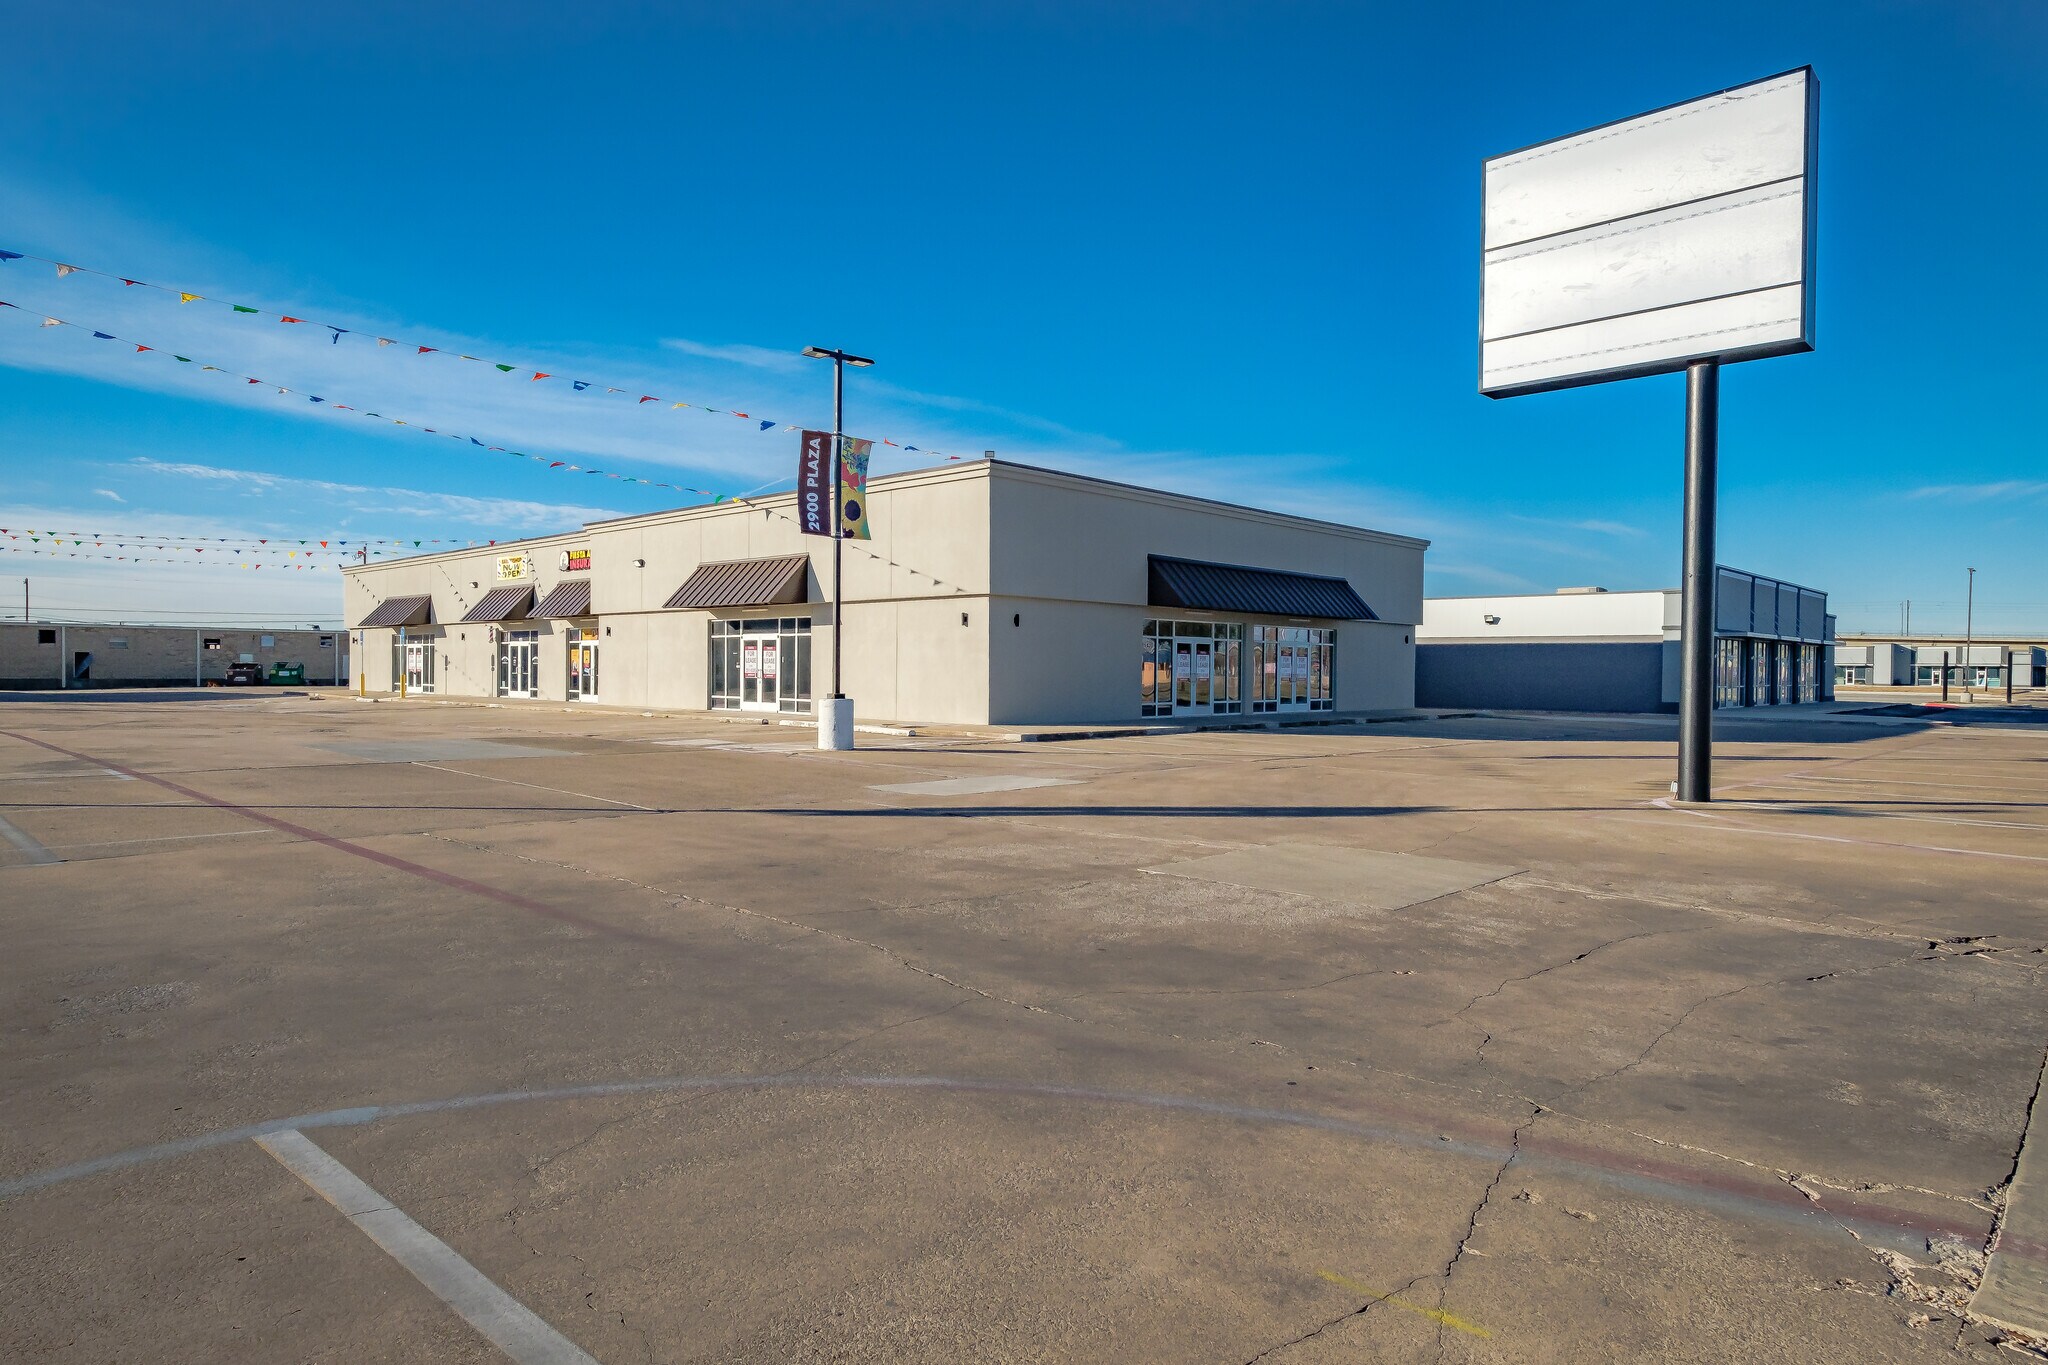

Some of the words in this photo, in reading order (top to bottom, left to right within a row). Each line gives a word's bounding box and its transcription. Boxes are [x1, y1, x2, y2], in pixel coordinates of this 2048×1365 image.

[806, 438, 821, 488] PLAZA
[805, 492, 820, 531] 2900
[502, 570, 522, 578] OPEN
[503, 563, 520, 571] NOW
